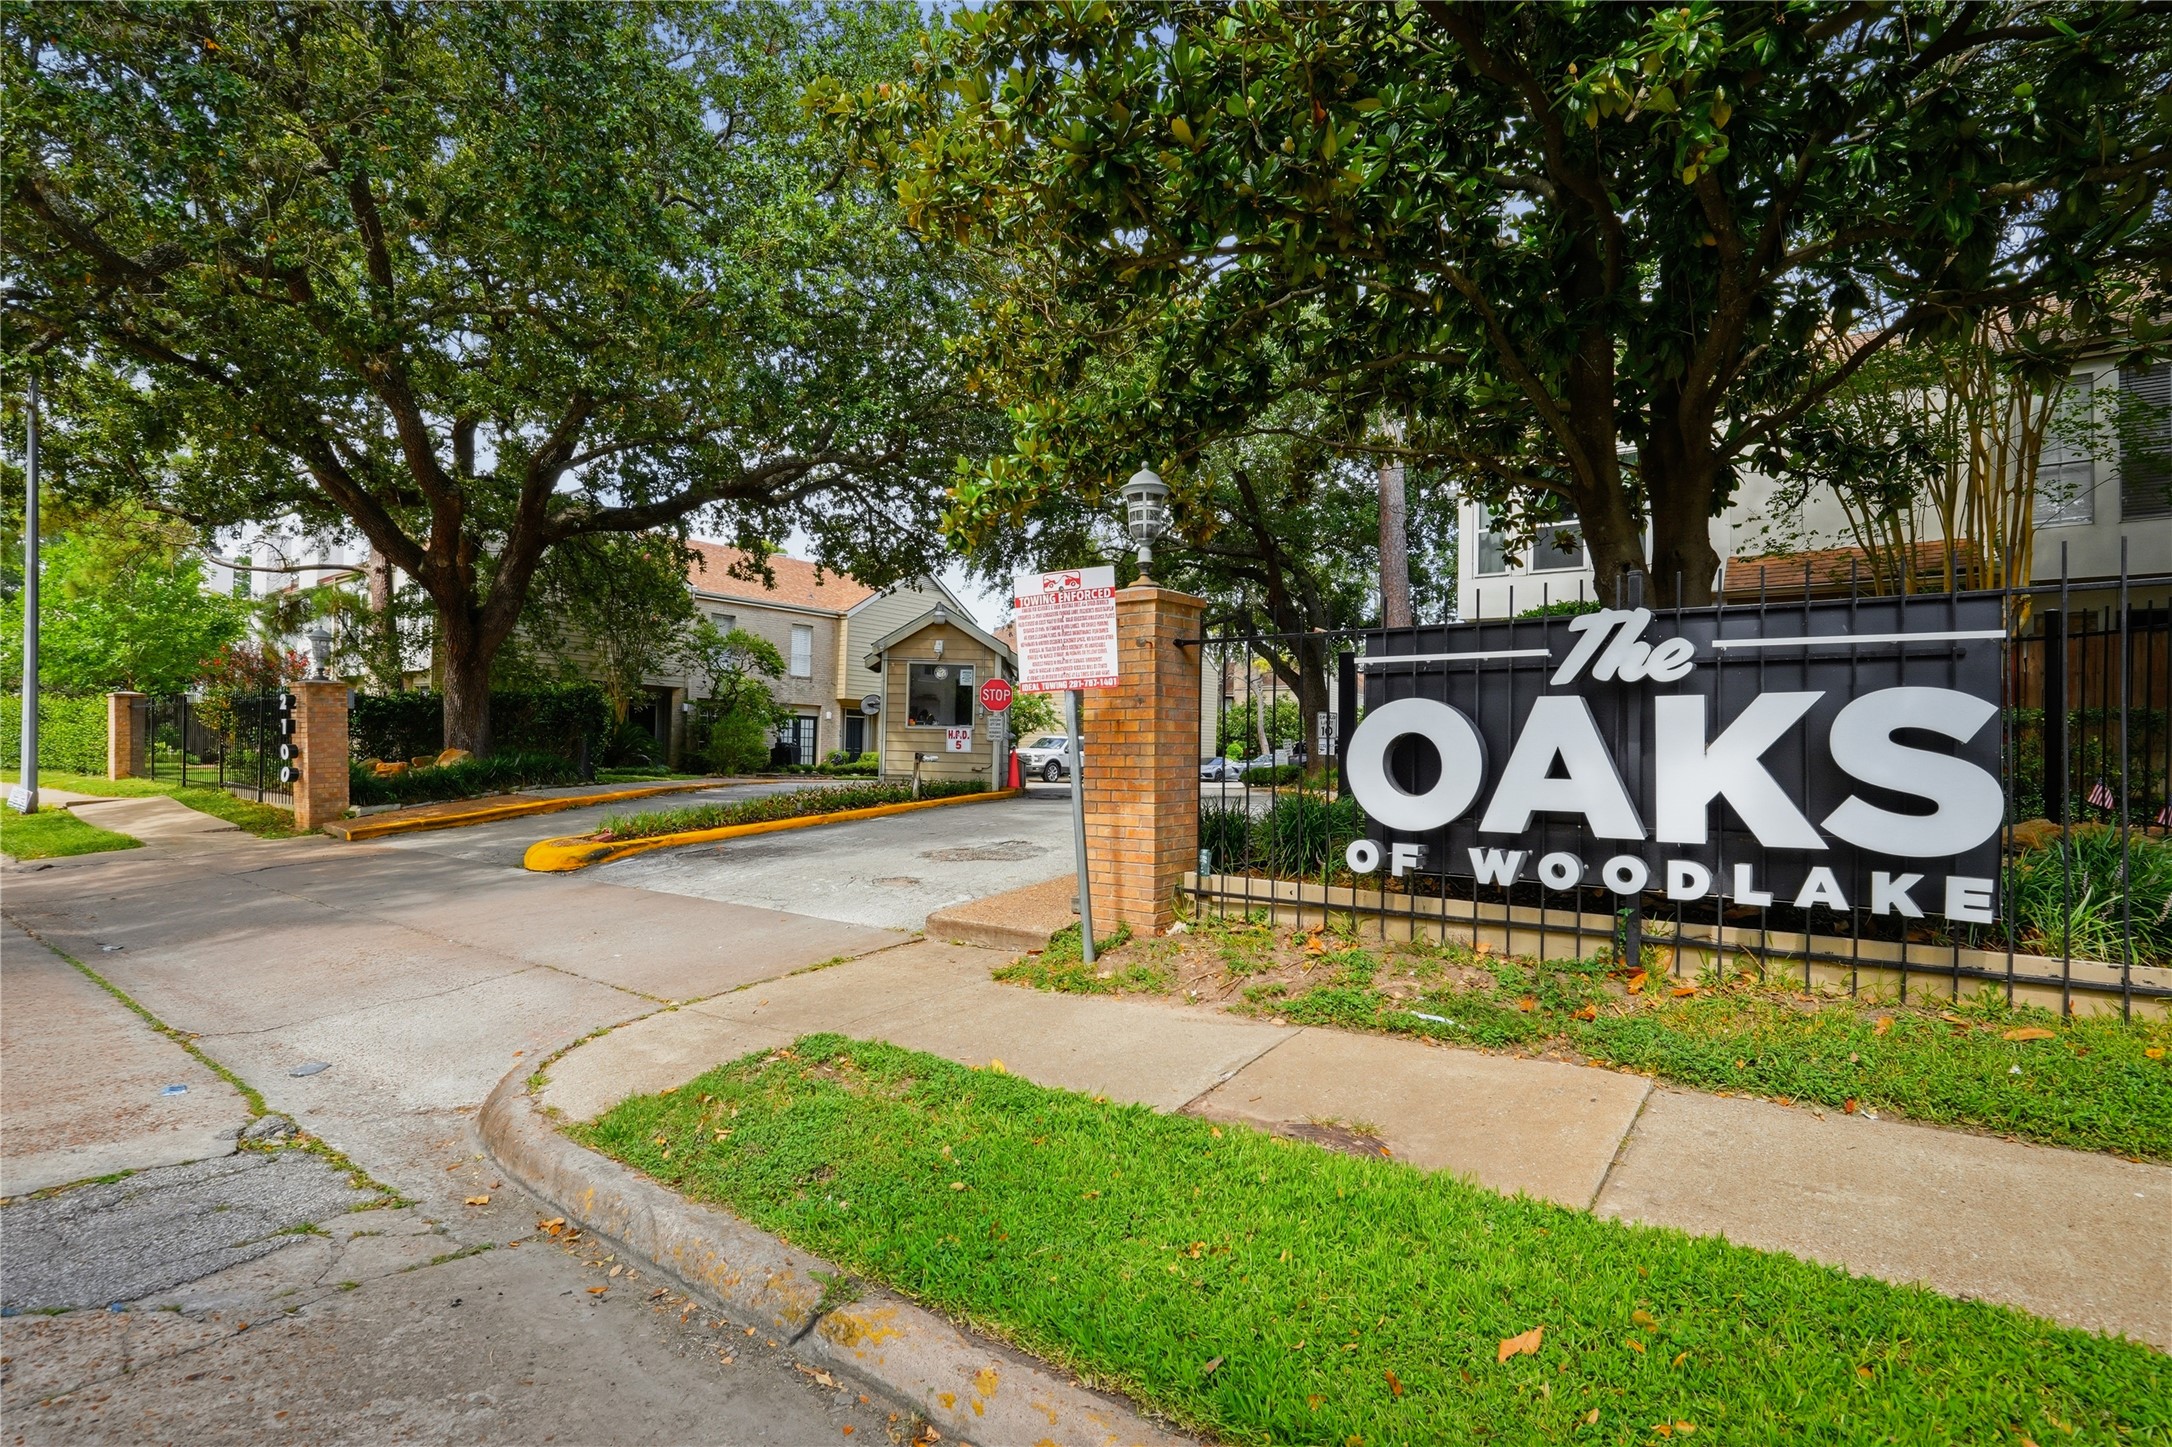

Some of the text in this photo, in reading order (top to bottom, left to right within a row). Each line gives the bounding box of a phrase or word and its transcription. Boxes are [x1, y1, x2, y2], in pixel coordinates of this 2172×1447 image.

[1019, 588, 1111, 607] TOWING ENFORCED
[1550, 606, 1697, 687] The
[982, 688, 1011, 702] STOP
[1021, 683, 1040, 692] IDEAL
[1041, 680, 1068, 691] TOWING
[279, 693, 290, 783] 2100
[955, 740, 962, 750] 5
[1346, 685, 2004, 858] OAKS
[1345, 838, 1995, 924] OF WOODLAKE
